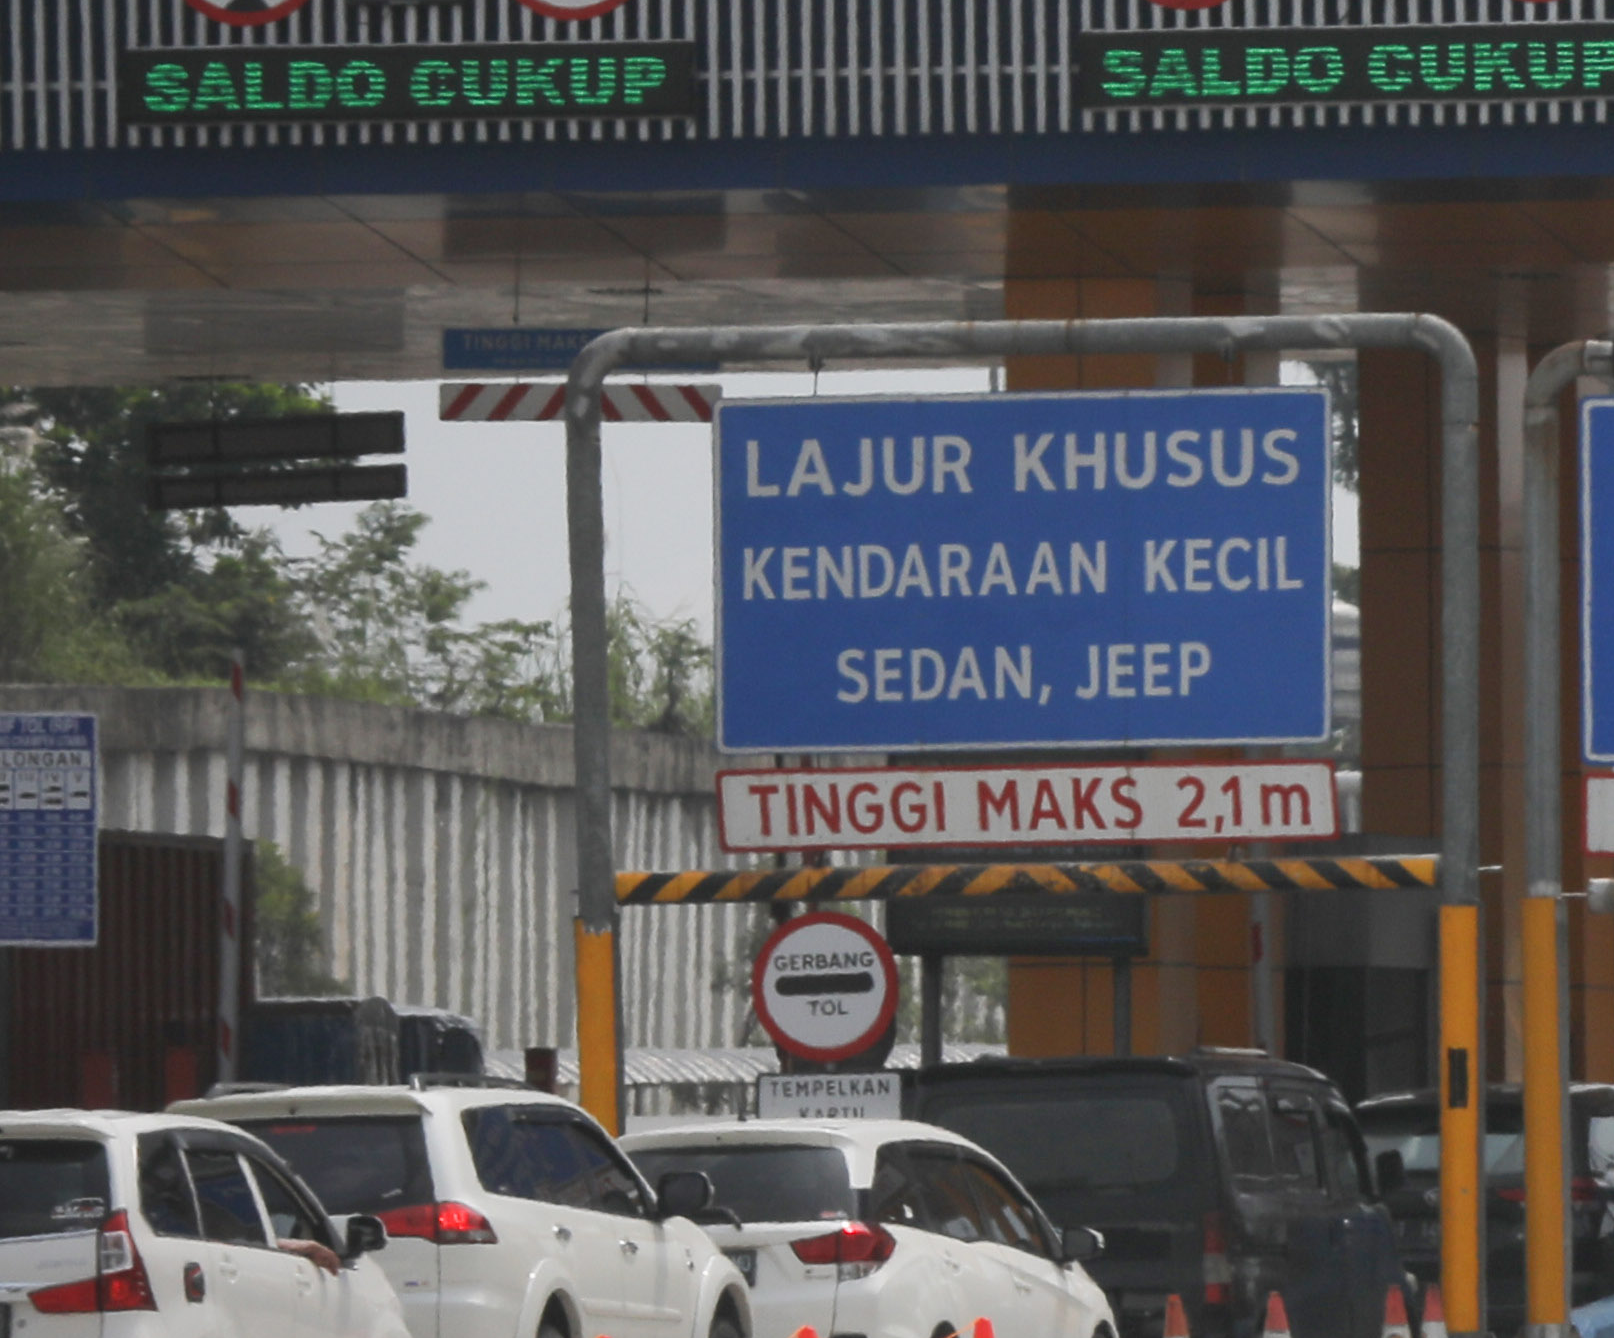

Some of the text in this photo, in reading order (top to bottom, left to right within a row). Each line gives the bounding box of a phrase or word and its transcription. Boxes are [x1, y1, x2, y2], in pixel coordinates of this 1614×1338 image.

[143, 55, 667, 113] SALDO CUKUP
[1101, 45, 1345, 98] SALDO
[747, 427, 1301, 497] LAJUR KHUSUS
[742, 535, 1303, 601] KENDARAAN KECIL
[836, 641, 1212, 705] SEDAN, JEEP
[1, 751, 82, 767] LONGAN
[749, 780, 945, 837] TINGGI
[977, 776, 1144, 831] MAKS
[774, 952, 874, 971] GERBANG
[806, 1000, 848, 1016] TOL
[771, 1079, 890, 1097] TEMPELKAN
